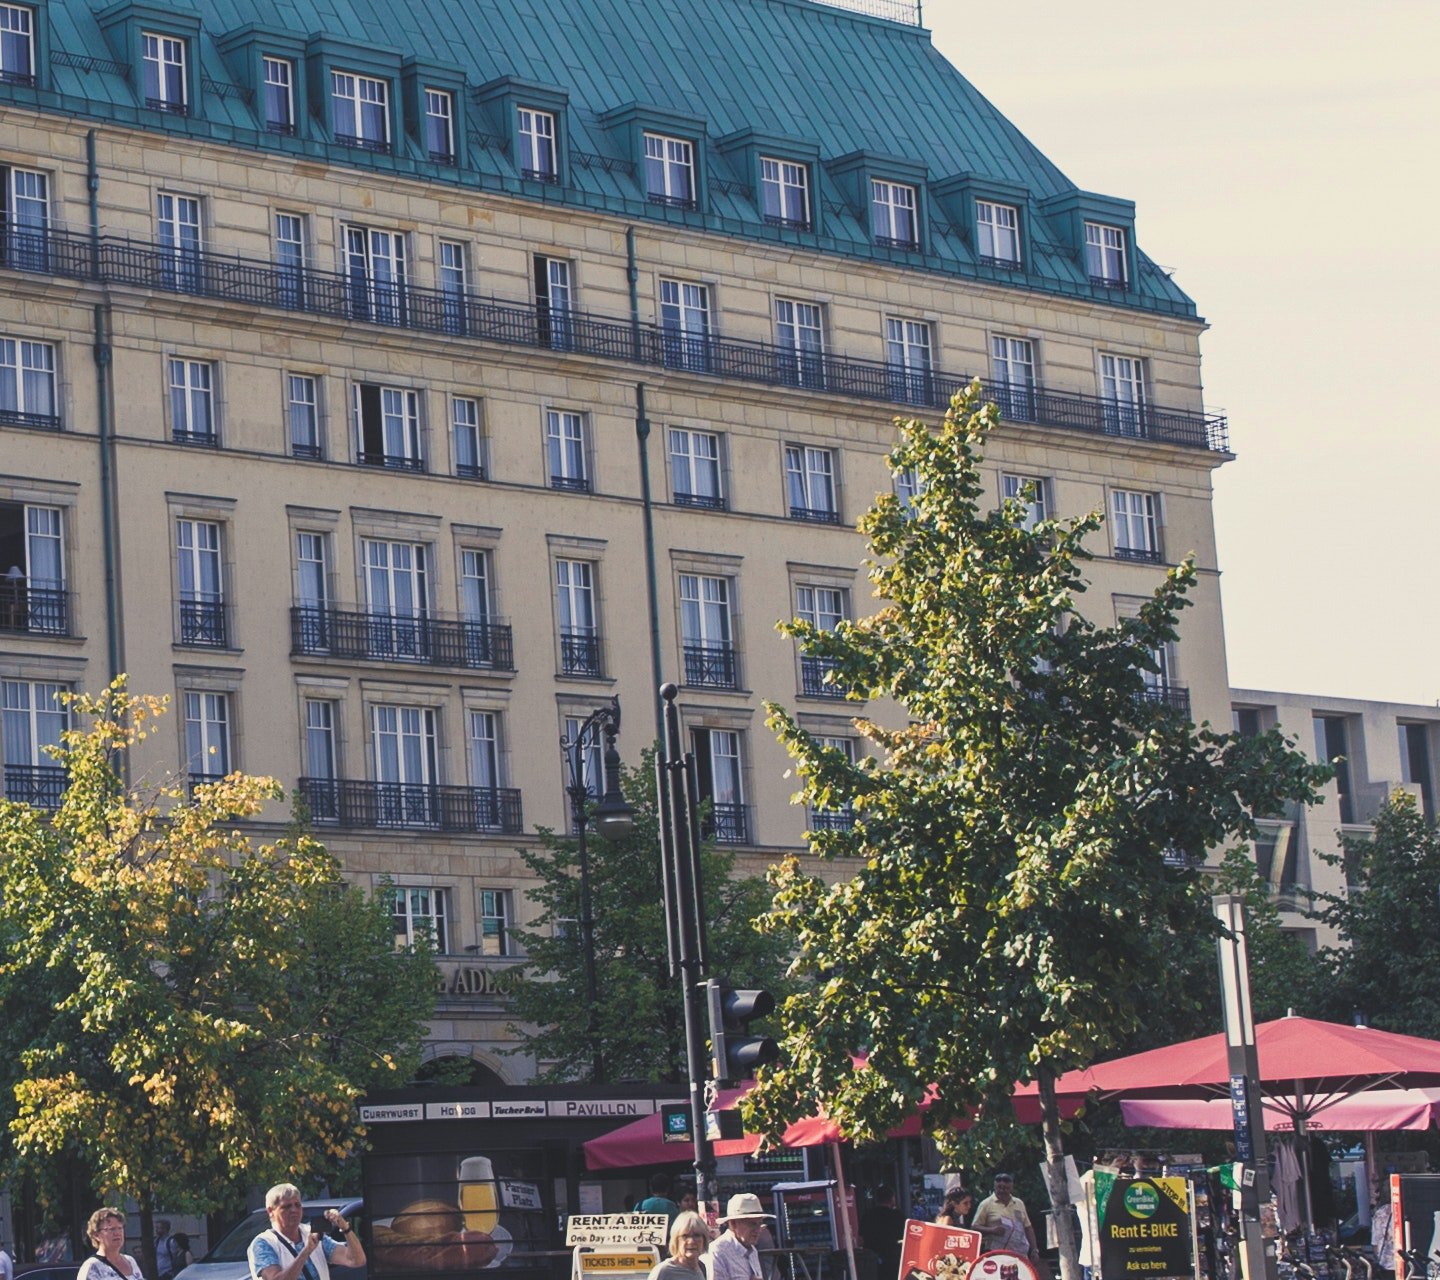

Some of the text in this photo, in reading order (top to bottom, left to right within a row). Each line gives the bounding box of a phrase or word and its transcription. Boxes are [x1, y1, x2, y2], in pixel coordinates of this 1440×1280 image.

[362, 1108, 420, 1119] CURRYWURST
[440, 1106, 477, 1116] HOOG
[566, 1101, 637, 1116] PAVILLON
[572, 1216, 666, 1226] RENT A BIKE
[1111, 1223, 1179, 1238] Rent E-BIKE
[570, 1234, 588, 1243] One
[590, 1234, 606, 1244] Day
[585, 1257, 637, 1268] TICKETS HIER
